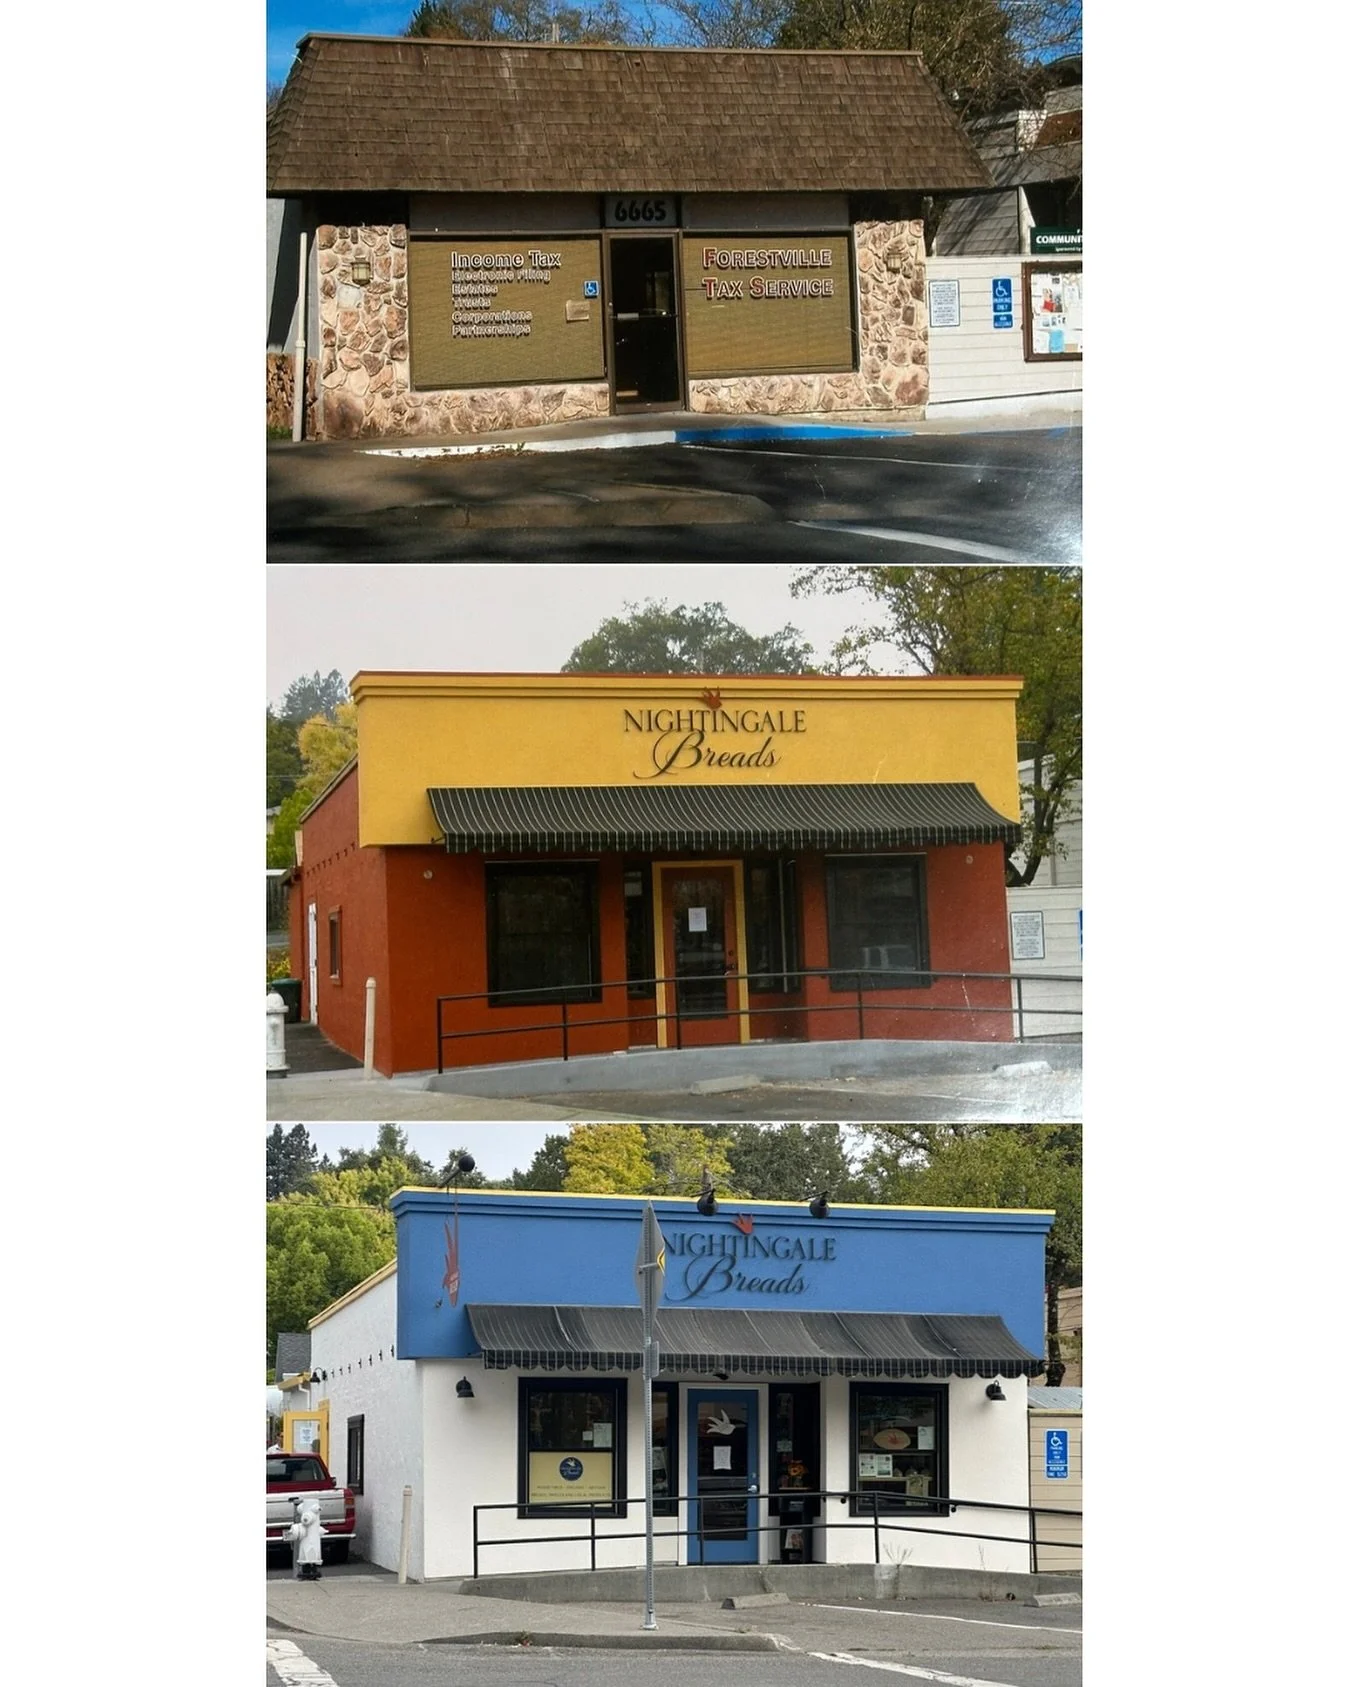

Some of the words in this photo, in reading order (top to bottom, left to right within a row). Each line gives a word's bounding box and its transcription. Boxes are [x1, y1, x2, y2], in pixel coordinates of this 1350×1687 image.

[614, 200, 667, 222] 6665
[1035, 235, 1082, 244] COMMUNI
[451, 251, 524, 269] Income
[528, 250, 562, 269] Tax
[702, 247, 832, 267] FORESTVILLE
[451, 269, 515, 282] Electronic
[702, 277, 743, 298] TAX
[750, 276, 834, 298] SERVICE
[451, 310, 533, 324] Corporations
[452, 324, 531, 338] Partnerships
[624, 708, 807, 733] NIGHTINGALE
[633, 727, 782, 780] Breads
[665, 1253, 810, 1302] Breads
